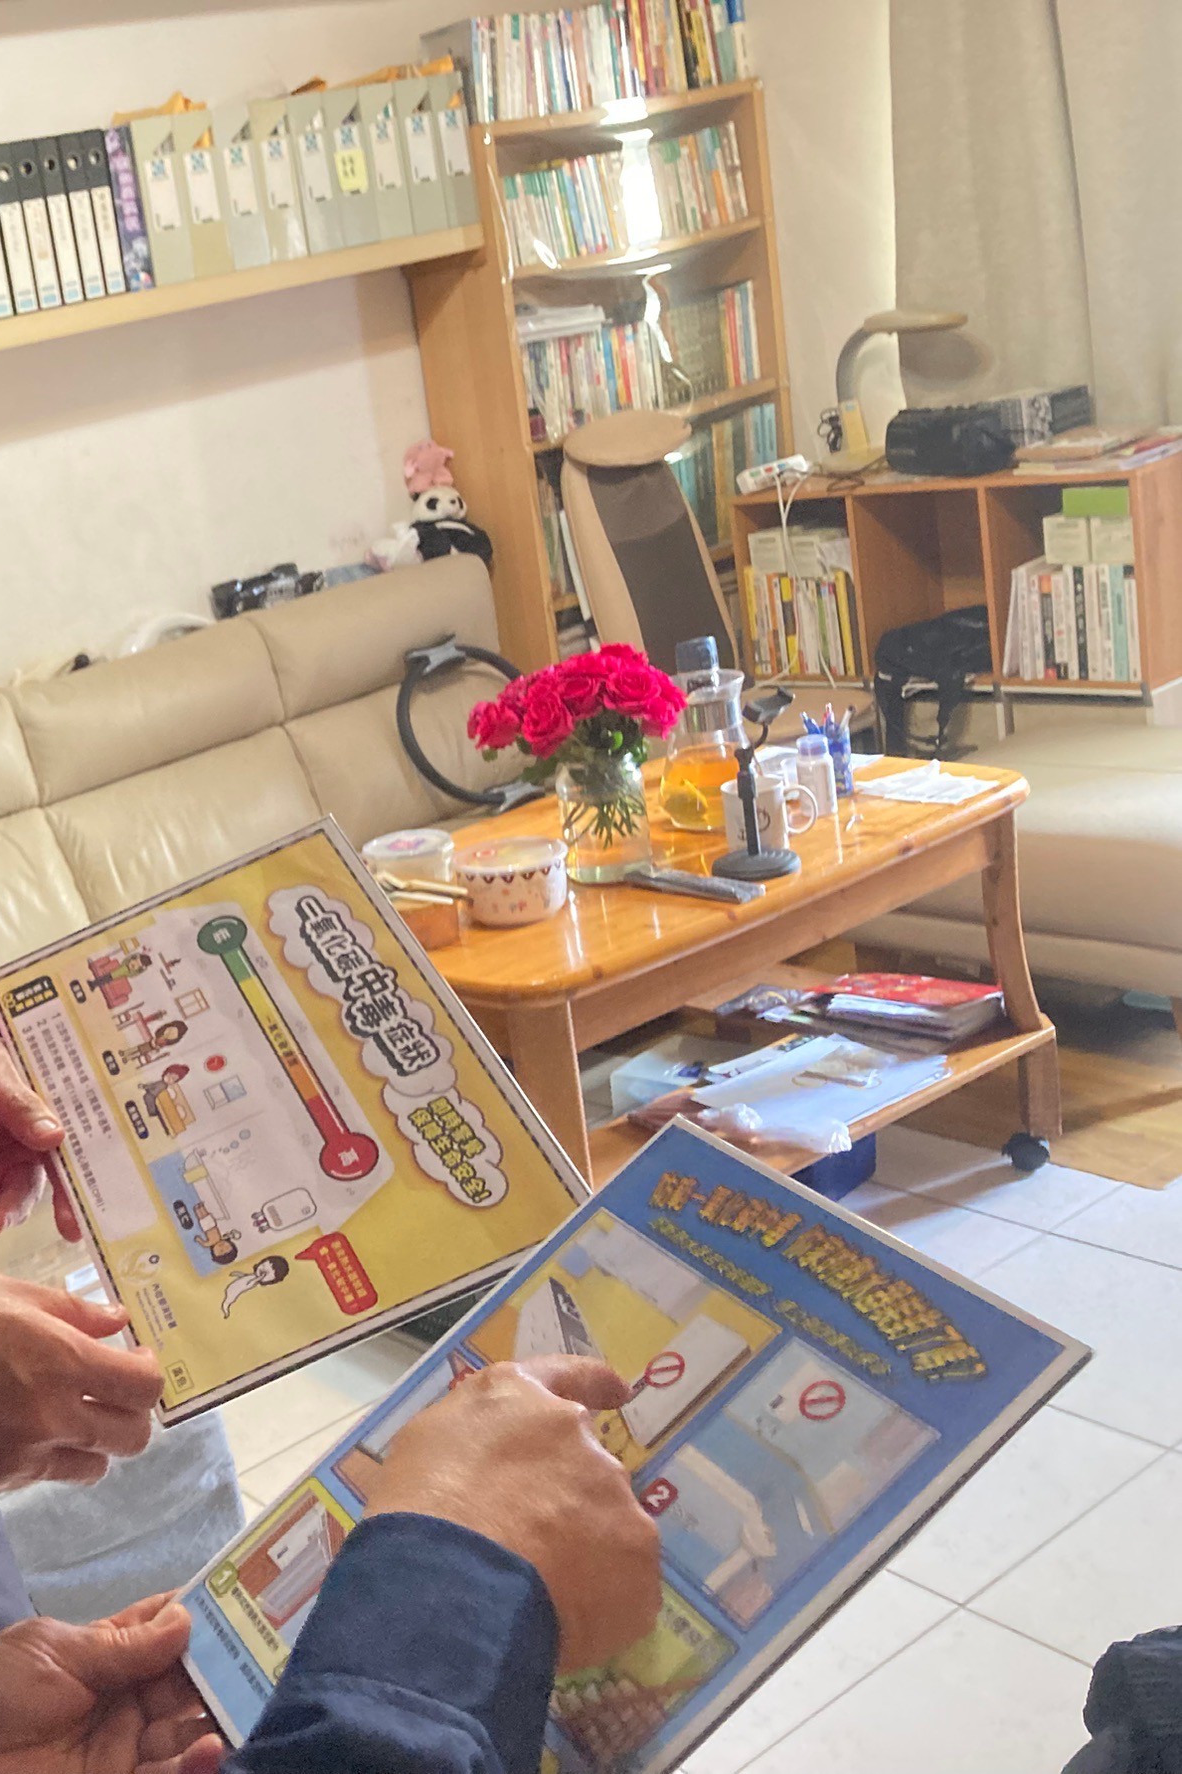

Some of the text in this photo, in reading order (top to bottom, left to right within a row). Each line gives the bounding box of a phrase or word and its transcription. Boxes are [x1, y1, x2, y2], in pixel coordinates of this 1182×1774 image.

[295, 896, 440, 1077] 一氧化碳中毒症狀
[646, 1485, 670, 1508] 2
